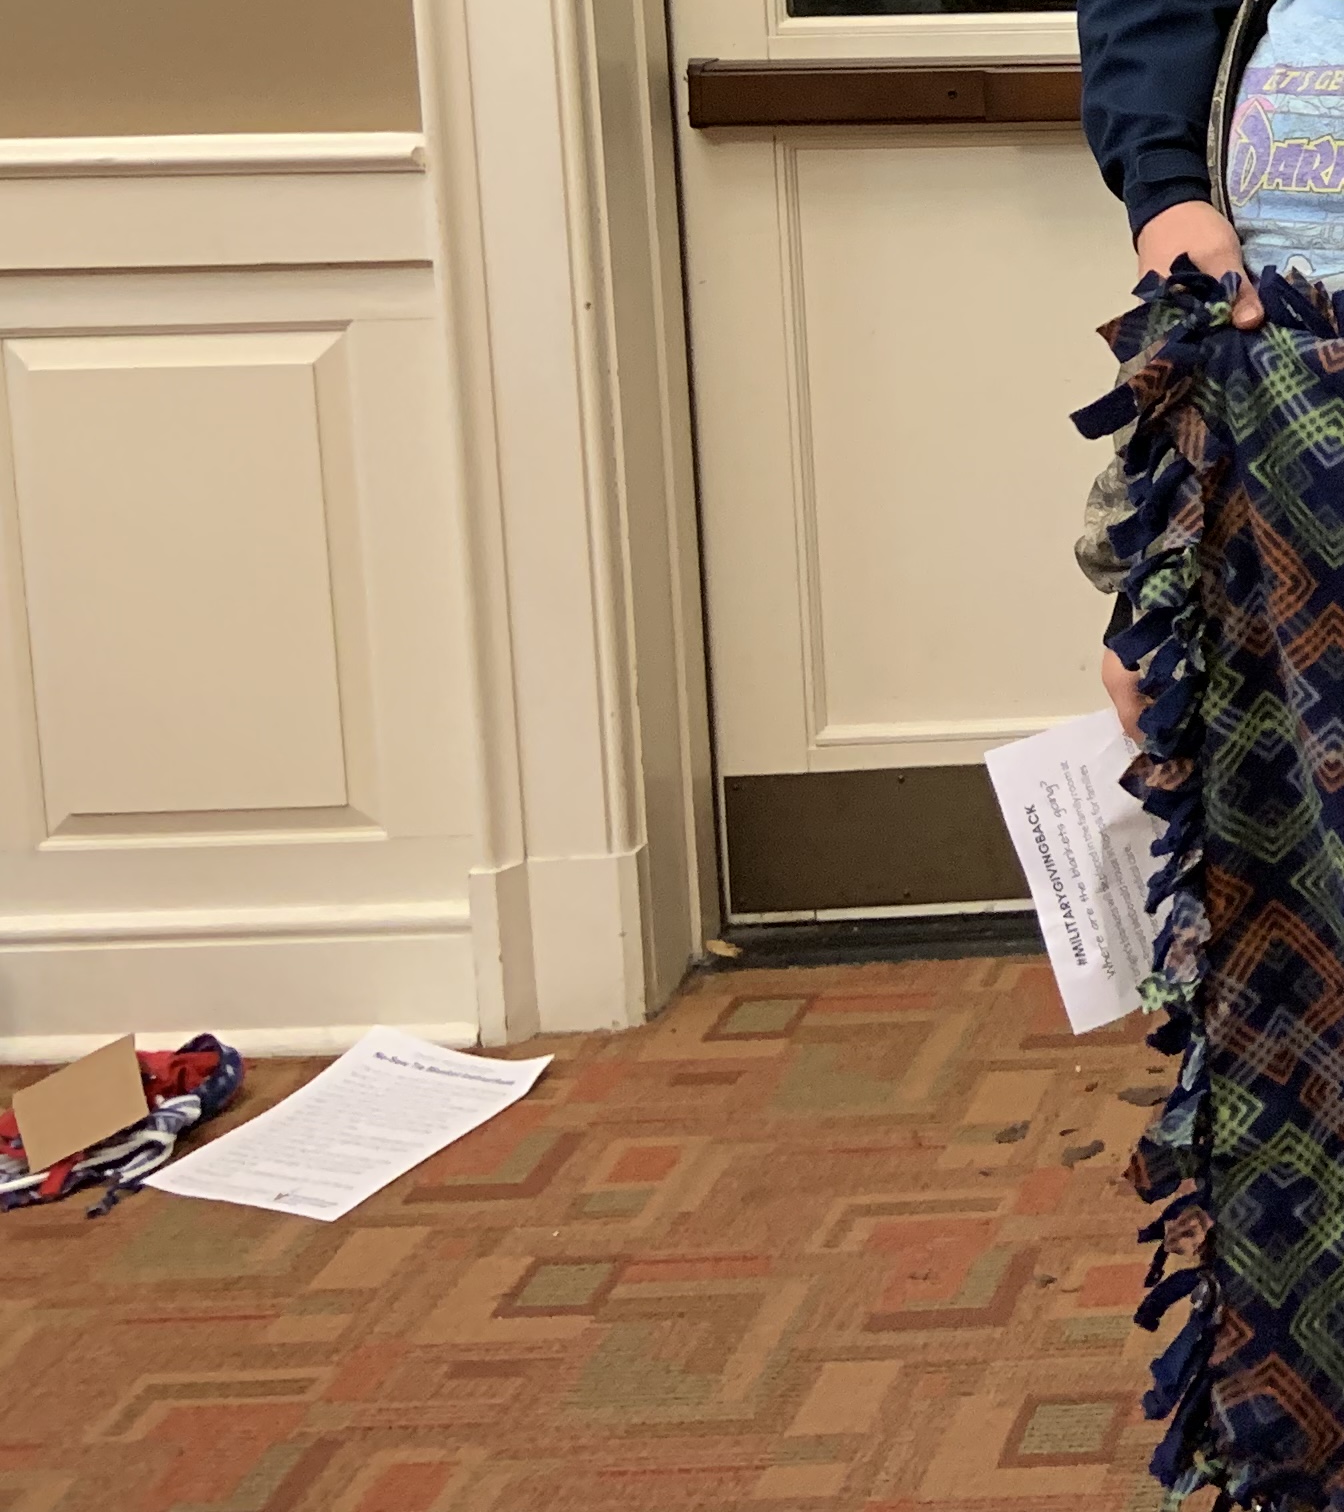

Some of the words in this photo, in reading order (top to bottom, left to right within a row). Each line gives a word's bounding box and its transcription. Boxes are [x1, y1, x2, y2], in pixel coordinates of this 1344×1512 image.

[1054, 823, 1080, 878] blankets
[1024, 804, 1088, 966] #MILITARYGIVINGBACK
[1075, 881, 1088, 902] the
[1085, 907, 1098, 931] are
[1093, 934, 1116, 979] Where
